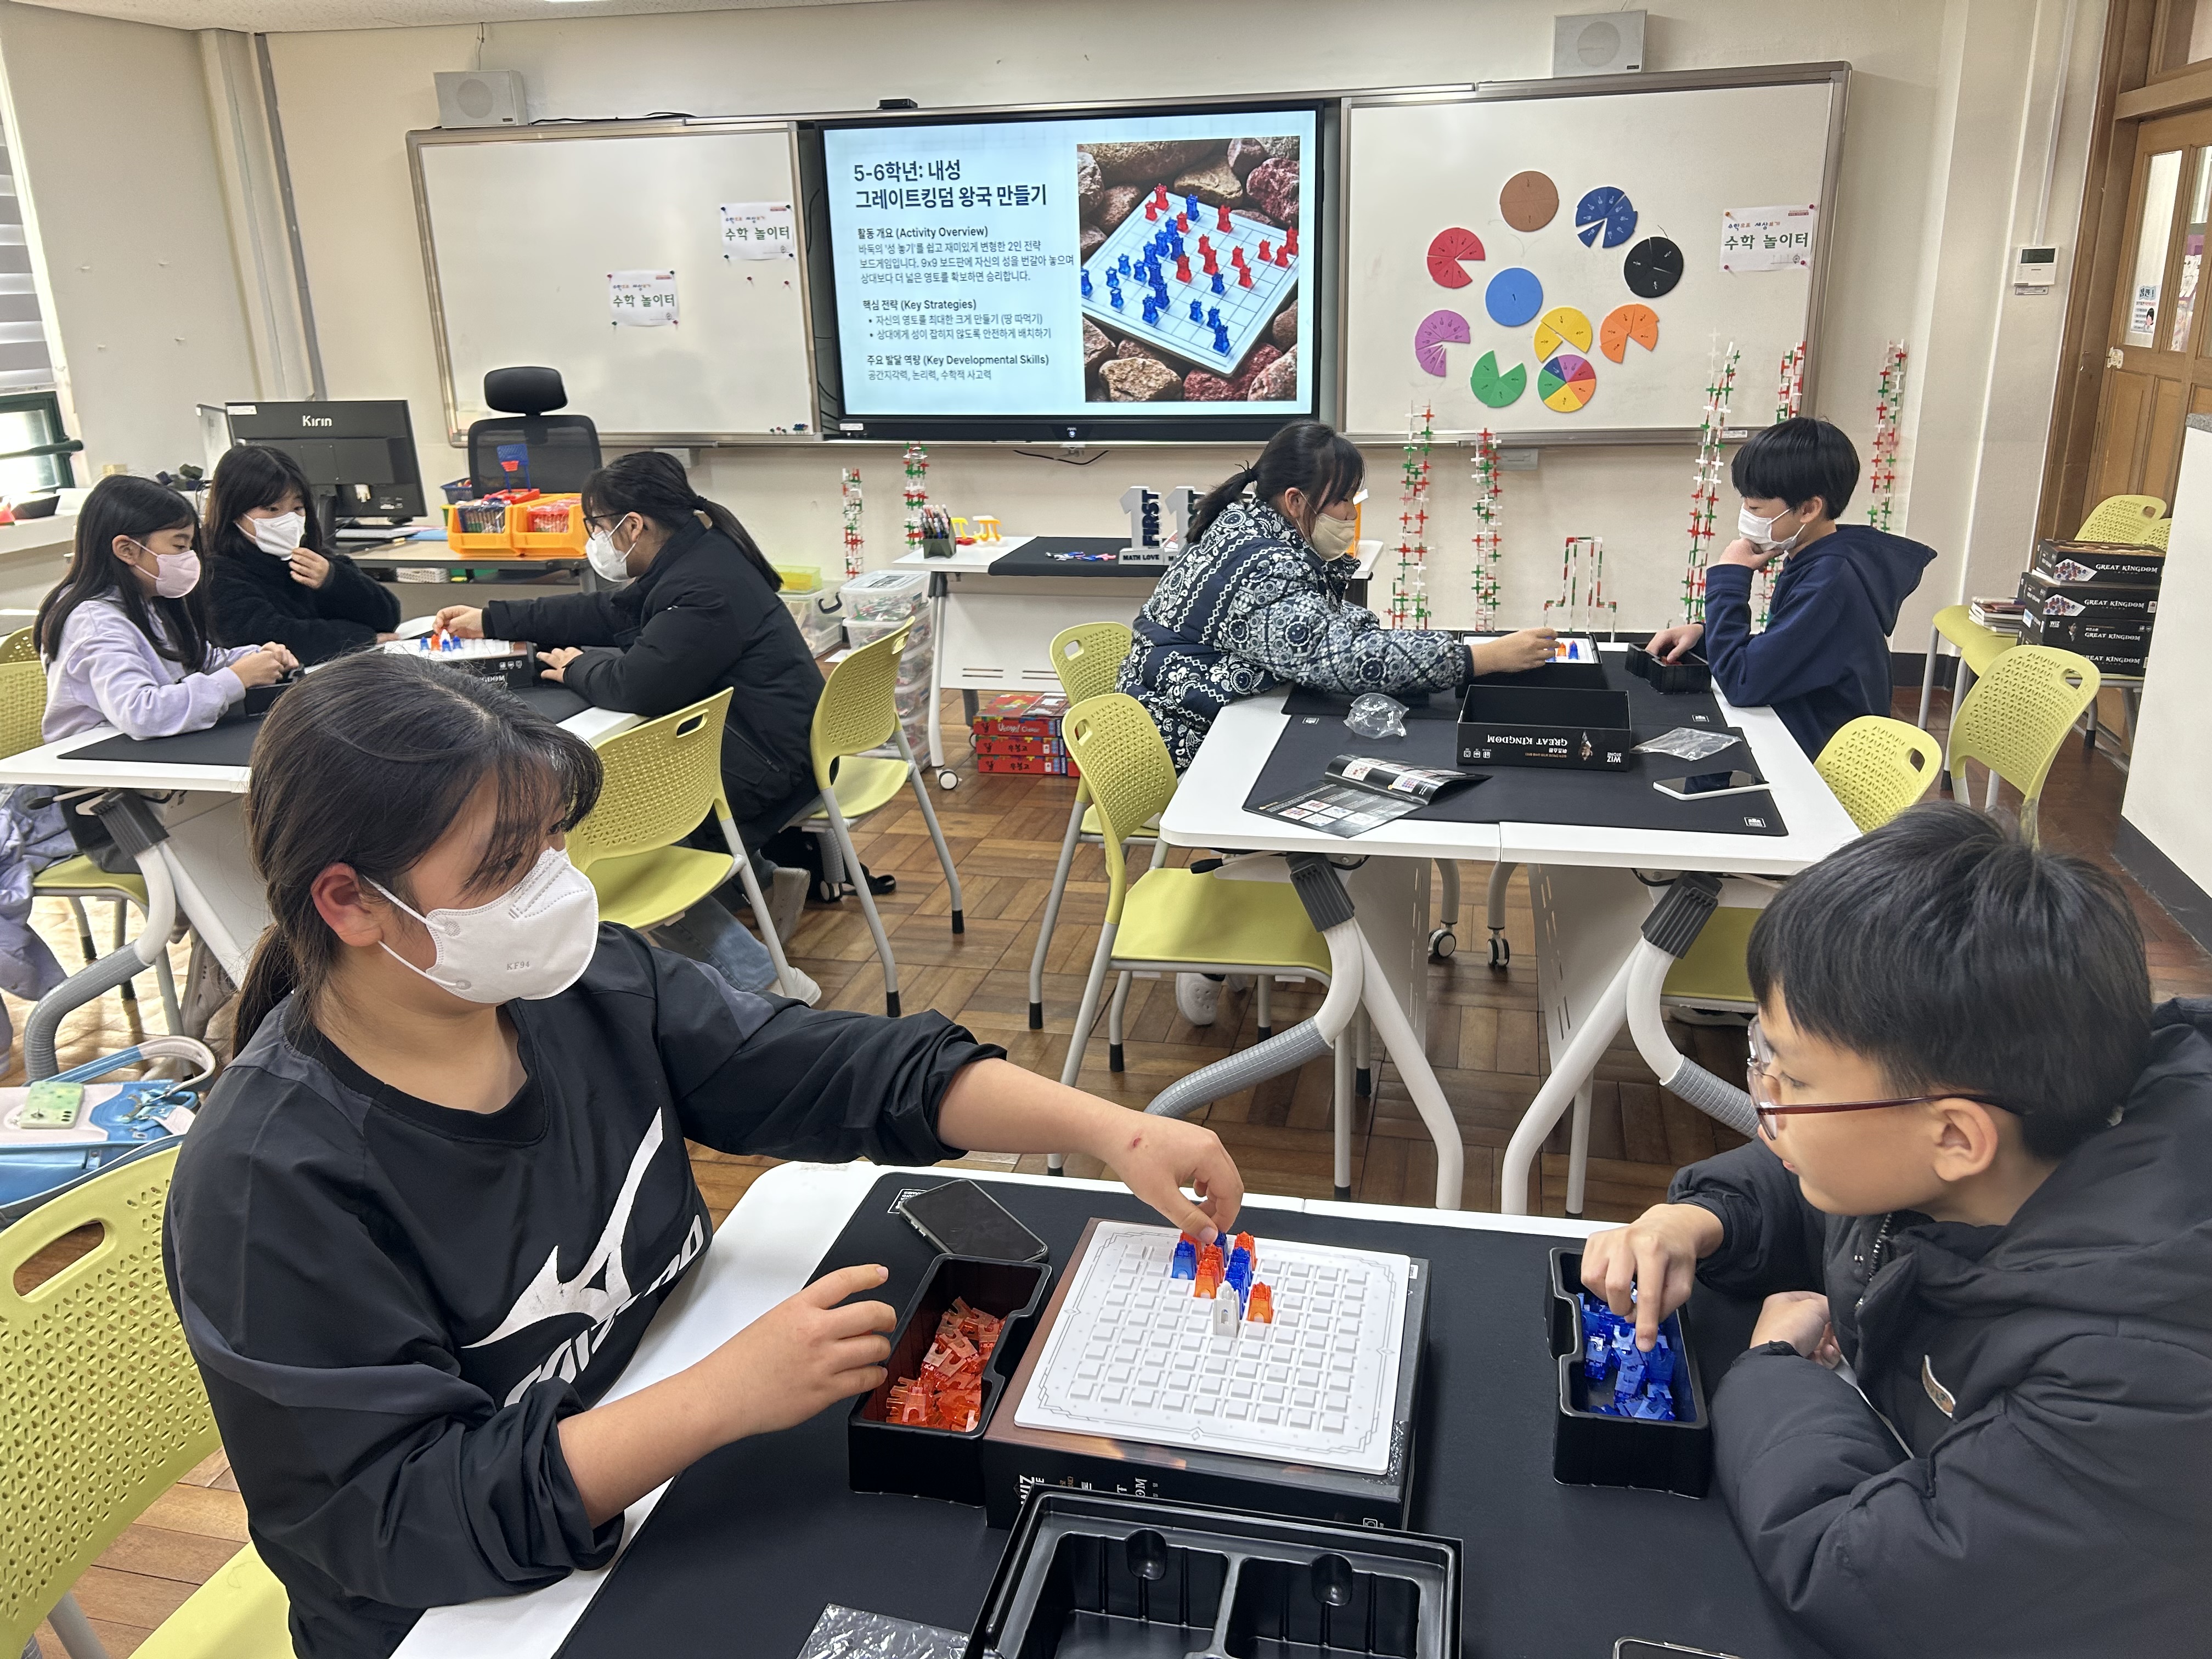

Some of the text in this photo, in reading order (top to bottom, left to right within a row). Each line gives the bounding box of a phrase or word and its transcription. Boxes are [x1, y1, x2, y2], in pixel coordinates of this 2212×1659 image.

[854, 160, 961, 182] 5-6학년: 내성
[856, 184, 1046, 210] 그레이트킹덤 왕국 만들기
[725, 226, 789, 241] 수학 놀이터
[857, 226, 988, 239] 활동 개요 (Activity Overview)
[859, 244, 883, 255] 바둑의
[927, 242, 943, 253] 쉽고
[945, 242, 978, 253] 재미있게
[980, 241, 1006, 252] 변형한
[1008, 241, 1022, 252] 2인
[1024, 240, 1041, 251] 전략
[1724, 233, 1808, 250] 수학 놀이터
[860, 255, 1074, 269] 보드게임입니다. 9x9 보드판에 자신의 성을 번갈아 놓으며
[861, 270, 1031, 284] 상대보다 더 넓은 영토를 확보하면 승리합니다.
[613, 294, 674, 307] 수학 놀이터
[863, 299, 976, 312] 핵심 전략 (Key Strategies)
[876, 313, 1043, 325] 자신의 영토를 최대한 크게 만들기 (땅 따먹기)
[877, 328, 1051, 340] 상대에게 성이 잡히지 않도록 안전하게 배치하기
[867, 354, 1049, 366] 주요 발달 역량 (Key Developmental Skills)
[868, 369, 991, 381] 공간지각력, 논리력, 수학적 사고력
[302, 415, 332, 427] Kirin
[1142, 489, 1159, 546] FIRST
[2122, 565, 2158, 574] KINGDOM
[2110, 600, 2145, 609] KINGDOM
[2108, 633, 2141, 641] KINGDOM
[2106, 656, 2141, 664] KINGDOM
[1487, 734, 1568, 747] GREAT KINGDOM
[506, 961, 531, 971] KF94
